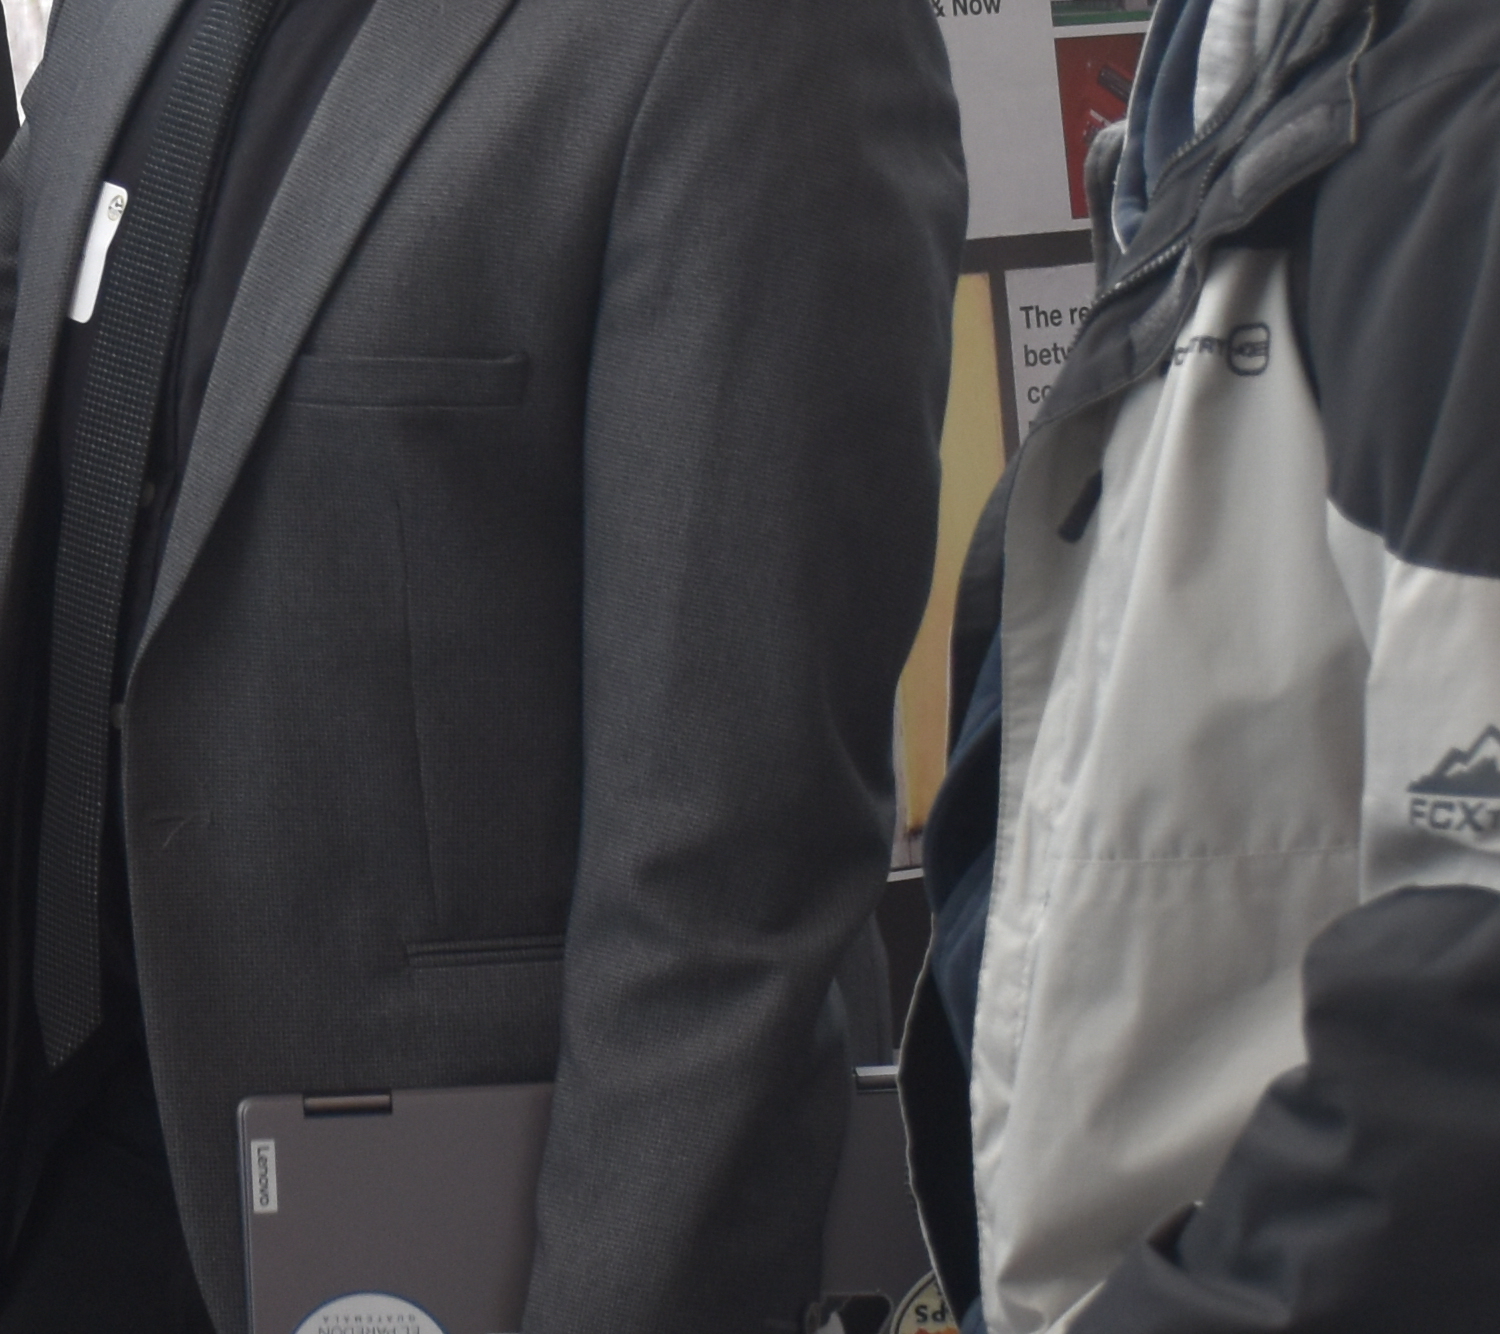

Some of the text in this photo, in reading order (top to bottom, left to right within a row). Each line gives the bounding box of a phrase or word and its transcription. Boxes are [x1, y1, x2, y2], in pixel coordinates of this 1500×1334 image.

[1019, 305, 1062, 329] The
[257, 1145, 270, 1207] Lenovo
[322, 1315, 416, 1324] GUATEMALA
